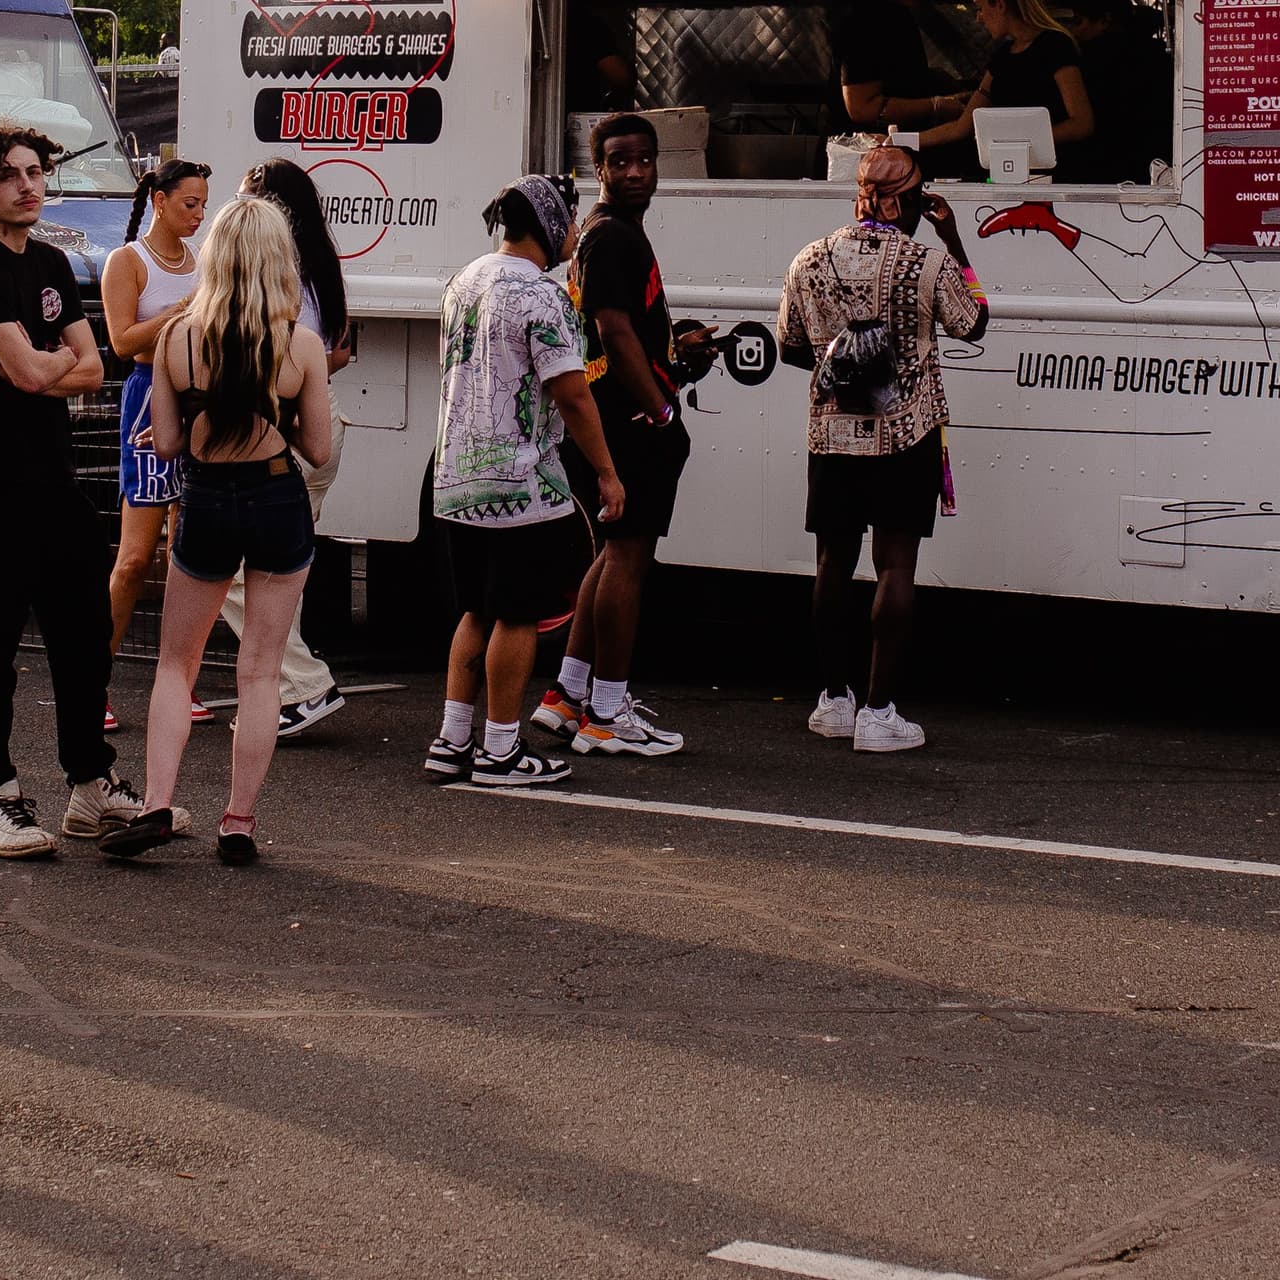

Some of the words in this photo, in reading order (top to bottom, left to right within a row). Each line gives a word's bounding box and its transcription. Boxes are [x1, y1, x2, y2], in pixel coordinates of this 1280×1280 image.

[1209, 12, 1249, 20] BURGER
[1254, 11, 1260, 19] &
[1209, 34, 1246, 42] CHEESE
[247, 36, 287, 57] FRESH
[289, 36, 324, 57] MADE
[327, 35, 382, 56] BURGERS
[385, 35, 394, 55] &
[397, 34, 447, 55] SHAKES
[1209, 56, 1244, 64] BACON
[1209, 78, 1246, 86] VEGGIE
[280, 91, 408, 151] BURGER
[1208, 150, 1244, 158] BACON
[1254, 173, 1274, 182] HOT
[1236, 193, 1279, 201] CHICKEN
[320, 196, 438, 226] URGERTO.COM
[1016, 352, 1105, 390] WANNA
[1113, 356, 1210, 396] BURGER
